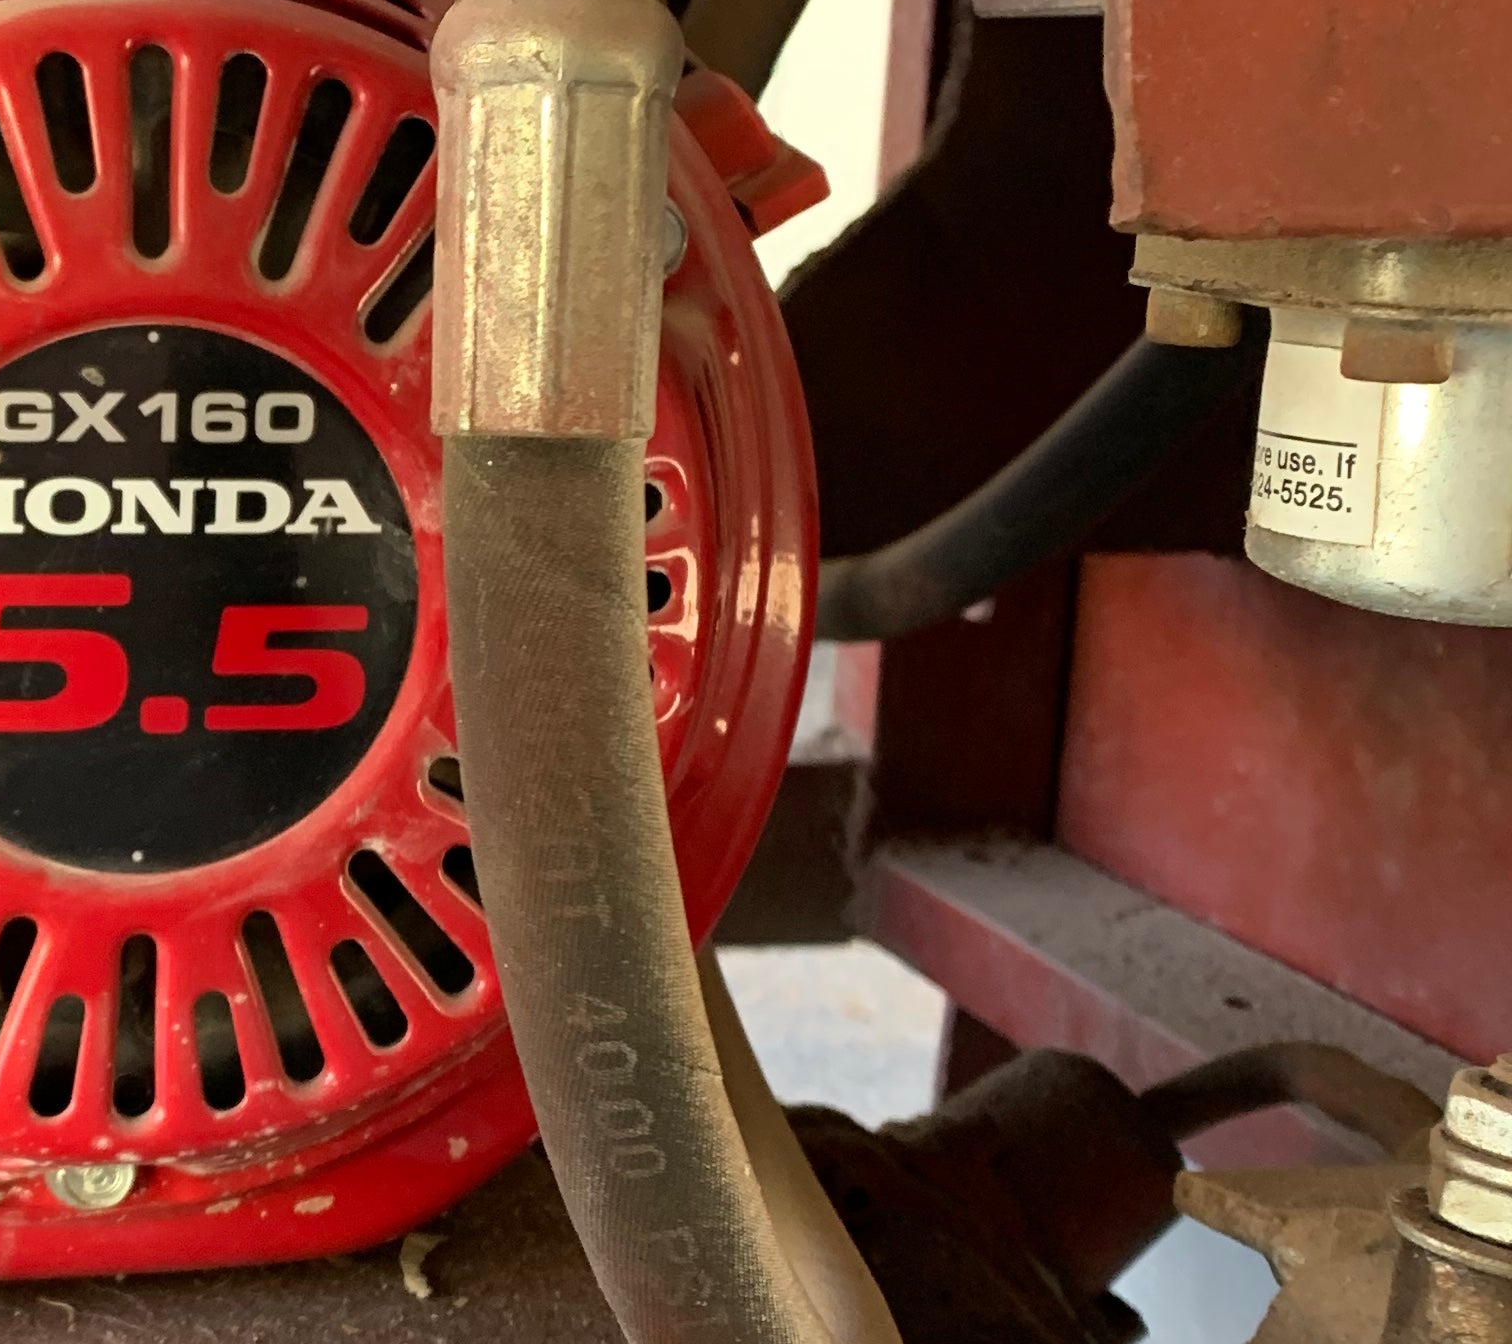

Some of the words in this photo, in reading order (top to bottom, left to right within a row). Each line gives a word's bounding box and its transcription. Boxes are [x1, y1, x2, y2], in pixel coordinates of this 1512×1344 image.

[1277, 449, 1324, 476] use.
[1336, 452, 1357, 479] If
[565, 991, 668, 1179] 4000
